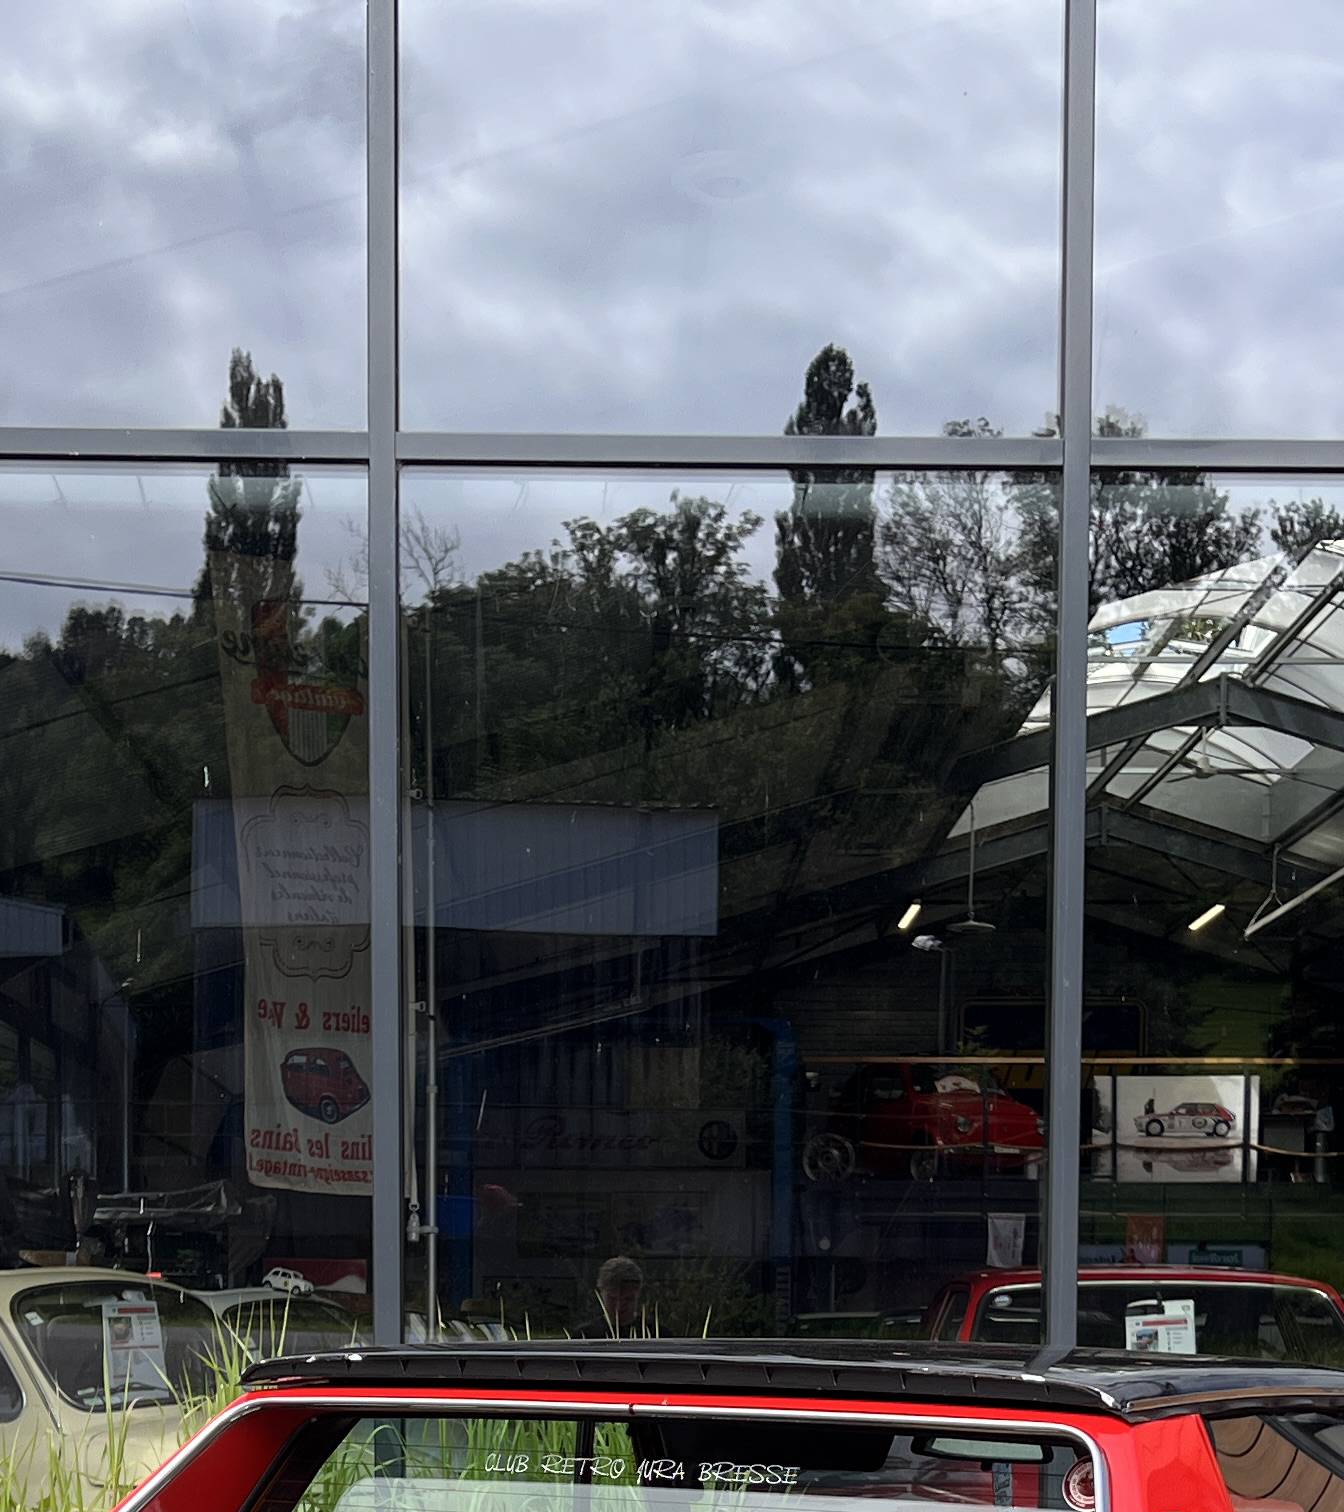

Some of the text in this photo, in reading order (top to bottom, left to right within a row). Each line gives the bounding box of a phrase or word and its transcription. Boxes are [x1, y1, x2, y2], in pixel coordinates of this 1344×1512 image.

[484, 1453, 801, 1485] CLUB RETRO JURA BRESSE
